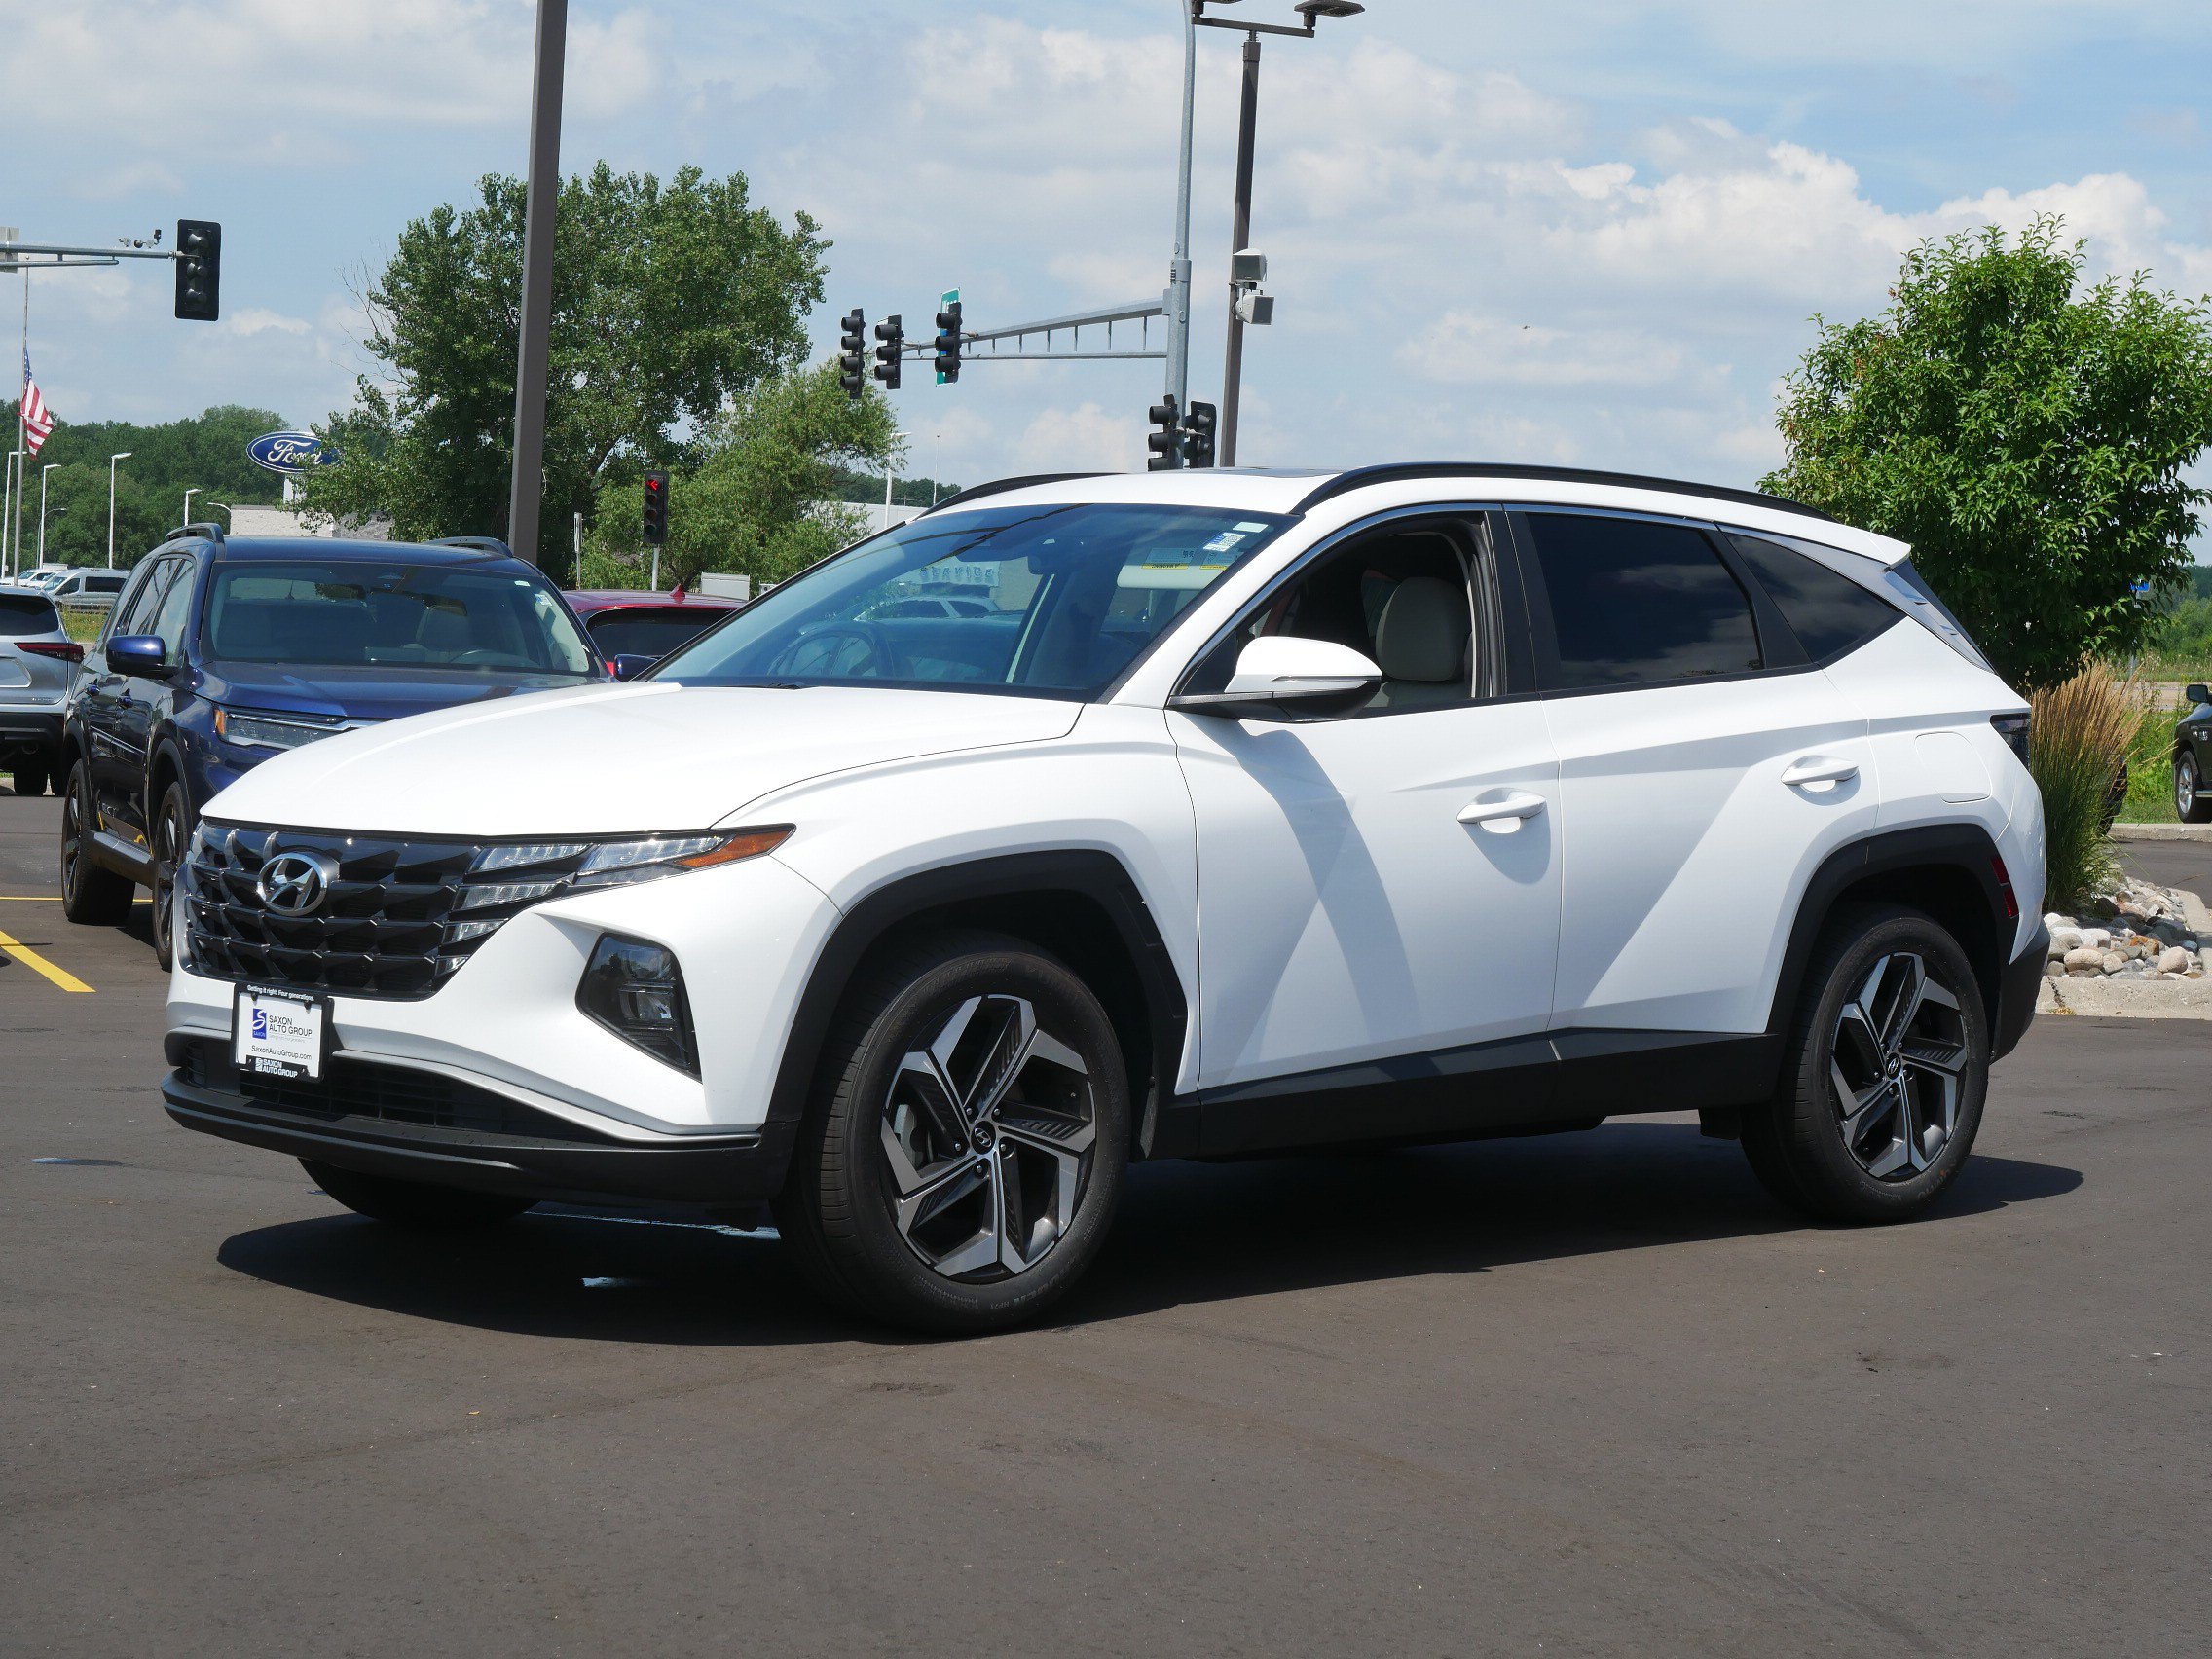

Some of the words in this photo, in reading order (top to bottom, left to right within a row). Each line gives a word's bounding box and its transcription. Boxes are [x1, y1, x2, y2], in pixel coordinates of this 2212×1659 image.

[267, 439, 323, 464] Ford
[246, 984, 263, 994] Getting
[269, 1015, 293, 1026] SAXON
[269, 1024, 287, 1034] AUTO
[288, 1026, 313, 1037] GROUP
[251, 1045, 313, 1061] SaxonAutoGroup.com
[263, 1059, 282, 1069] SAXON
[263, 1066, 277, 1075] AUTO
[278, 1069, 298, 1078] GROUP
